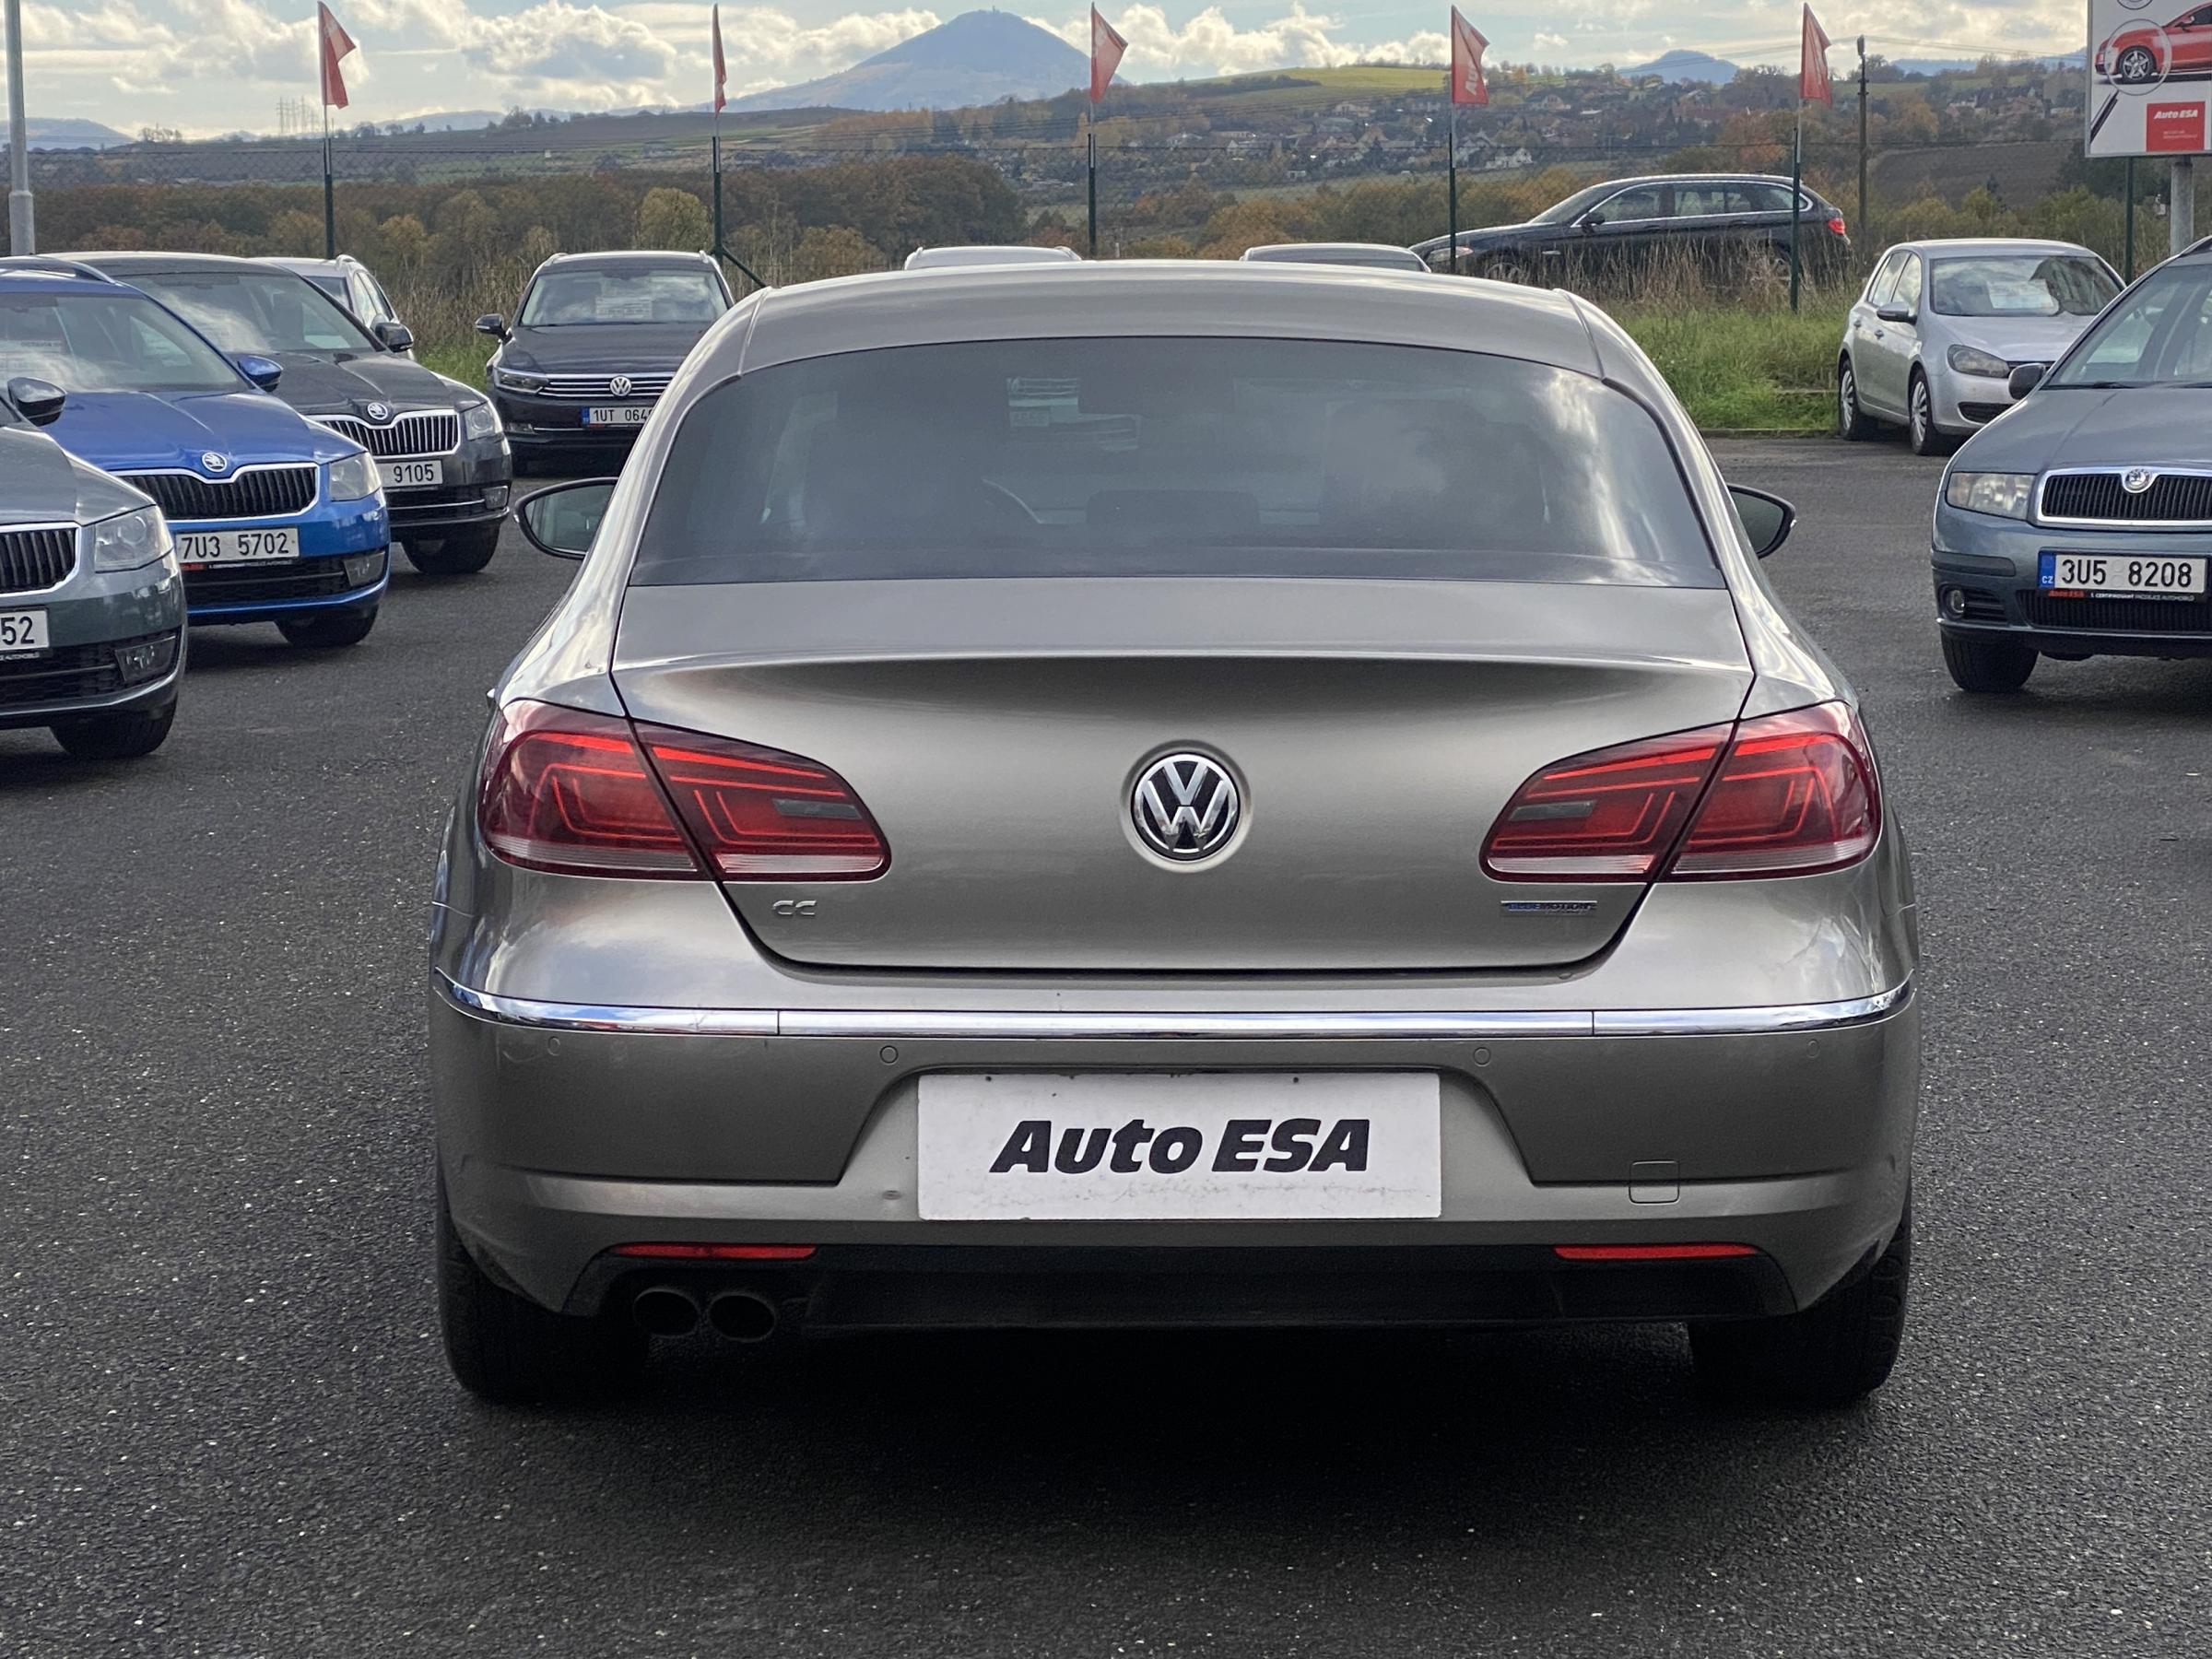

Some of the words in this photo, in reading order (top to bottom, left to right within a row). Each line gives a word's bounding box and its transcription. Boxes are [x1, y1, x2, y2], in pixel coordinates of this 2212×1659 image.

[2154, 111, 2179, 119] Auto
[2179, 109, 2198, 118] ESA
[593, 409, 615, 422] 1UT
[393, 464, 434, 483] 9105
[181, 535, 221, 559] 7U3
[238, 532, 289, 556] 5702
[2041, 575, 2054, 584] CZ
[2062, 559, 2108, 585] 3U5
[2128, 560, 2193, 588] 8208
[1, 616, 35, 645] 52
[771, 900, 818, 915] CC
[988, 1118, 1203, 1174] Auto
[1211, 1118, 1371, 1173] ESA
